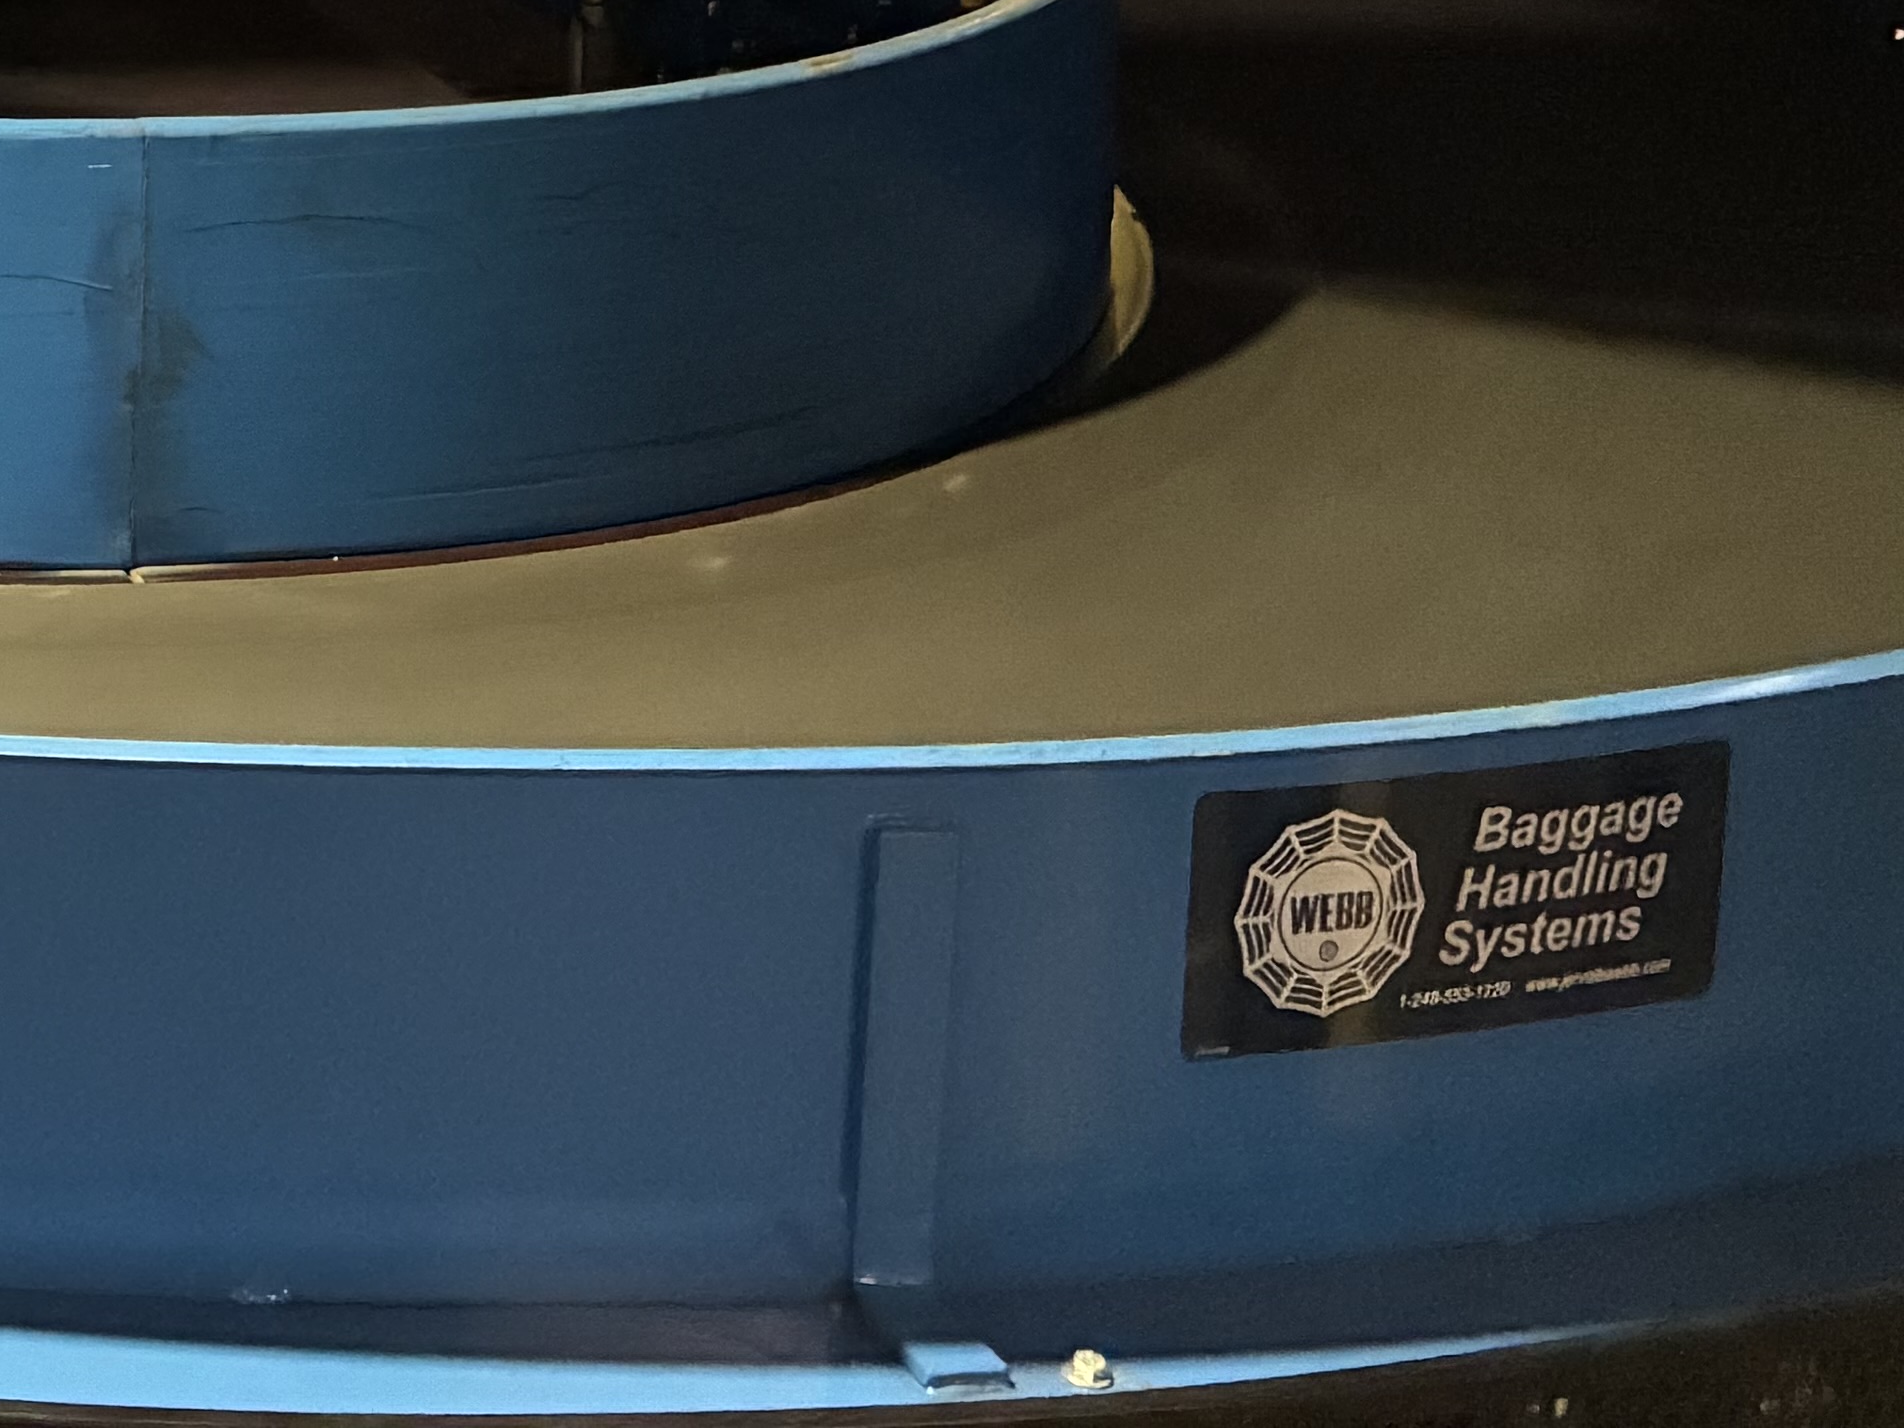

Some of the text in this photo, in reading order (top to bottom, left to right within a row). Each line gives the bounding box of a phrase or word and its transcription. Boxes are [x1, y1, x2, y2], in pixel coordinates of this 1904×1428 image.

[1473, 792, 1684, 855] Baggage
[1456, 849, 1668, 912] Handling
[1290, 890, 1374, 936] WEBB
[1439, 906, 1642, 973] Systems
